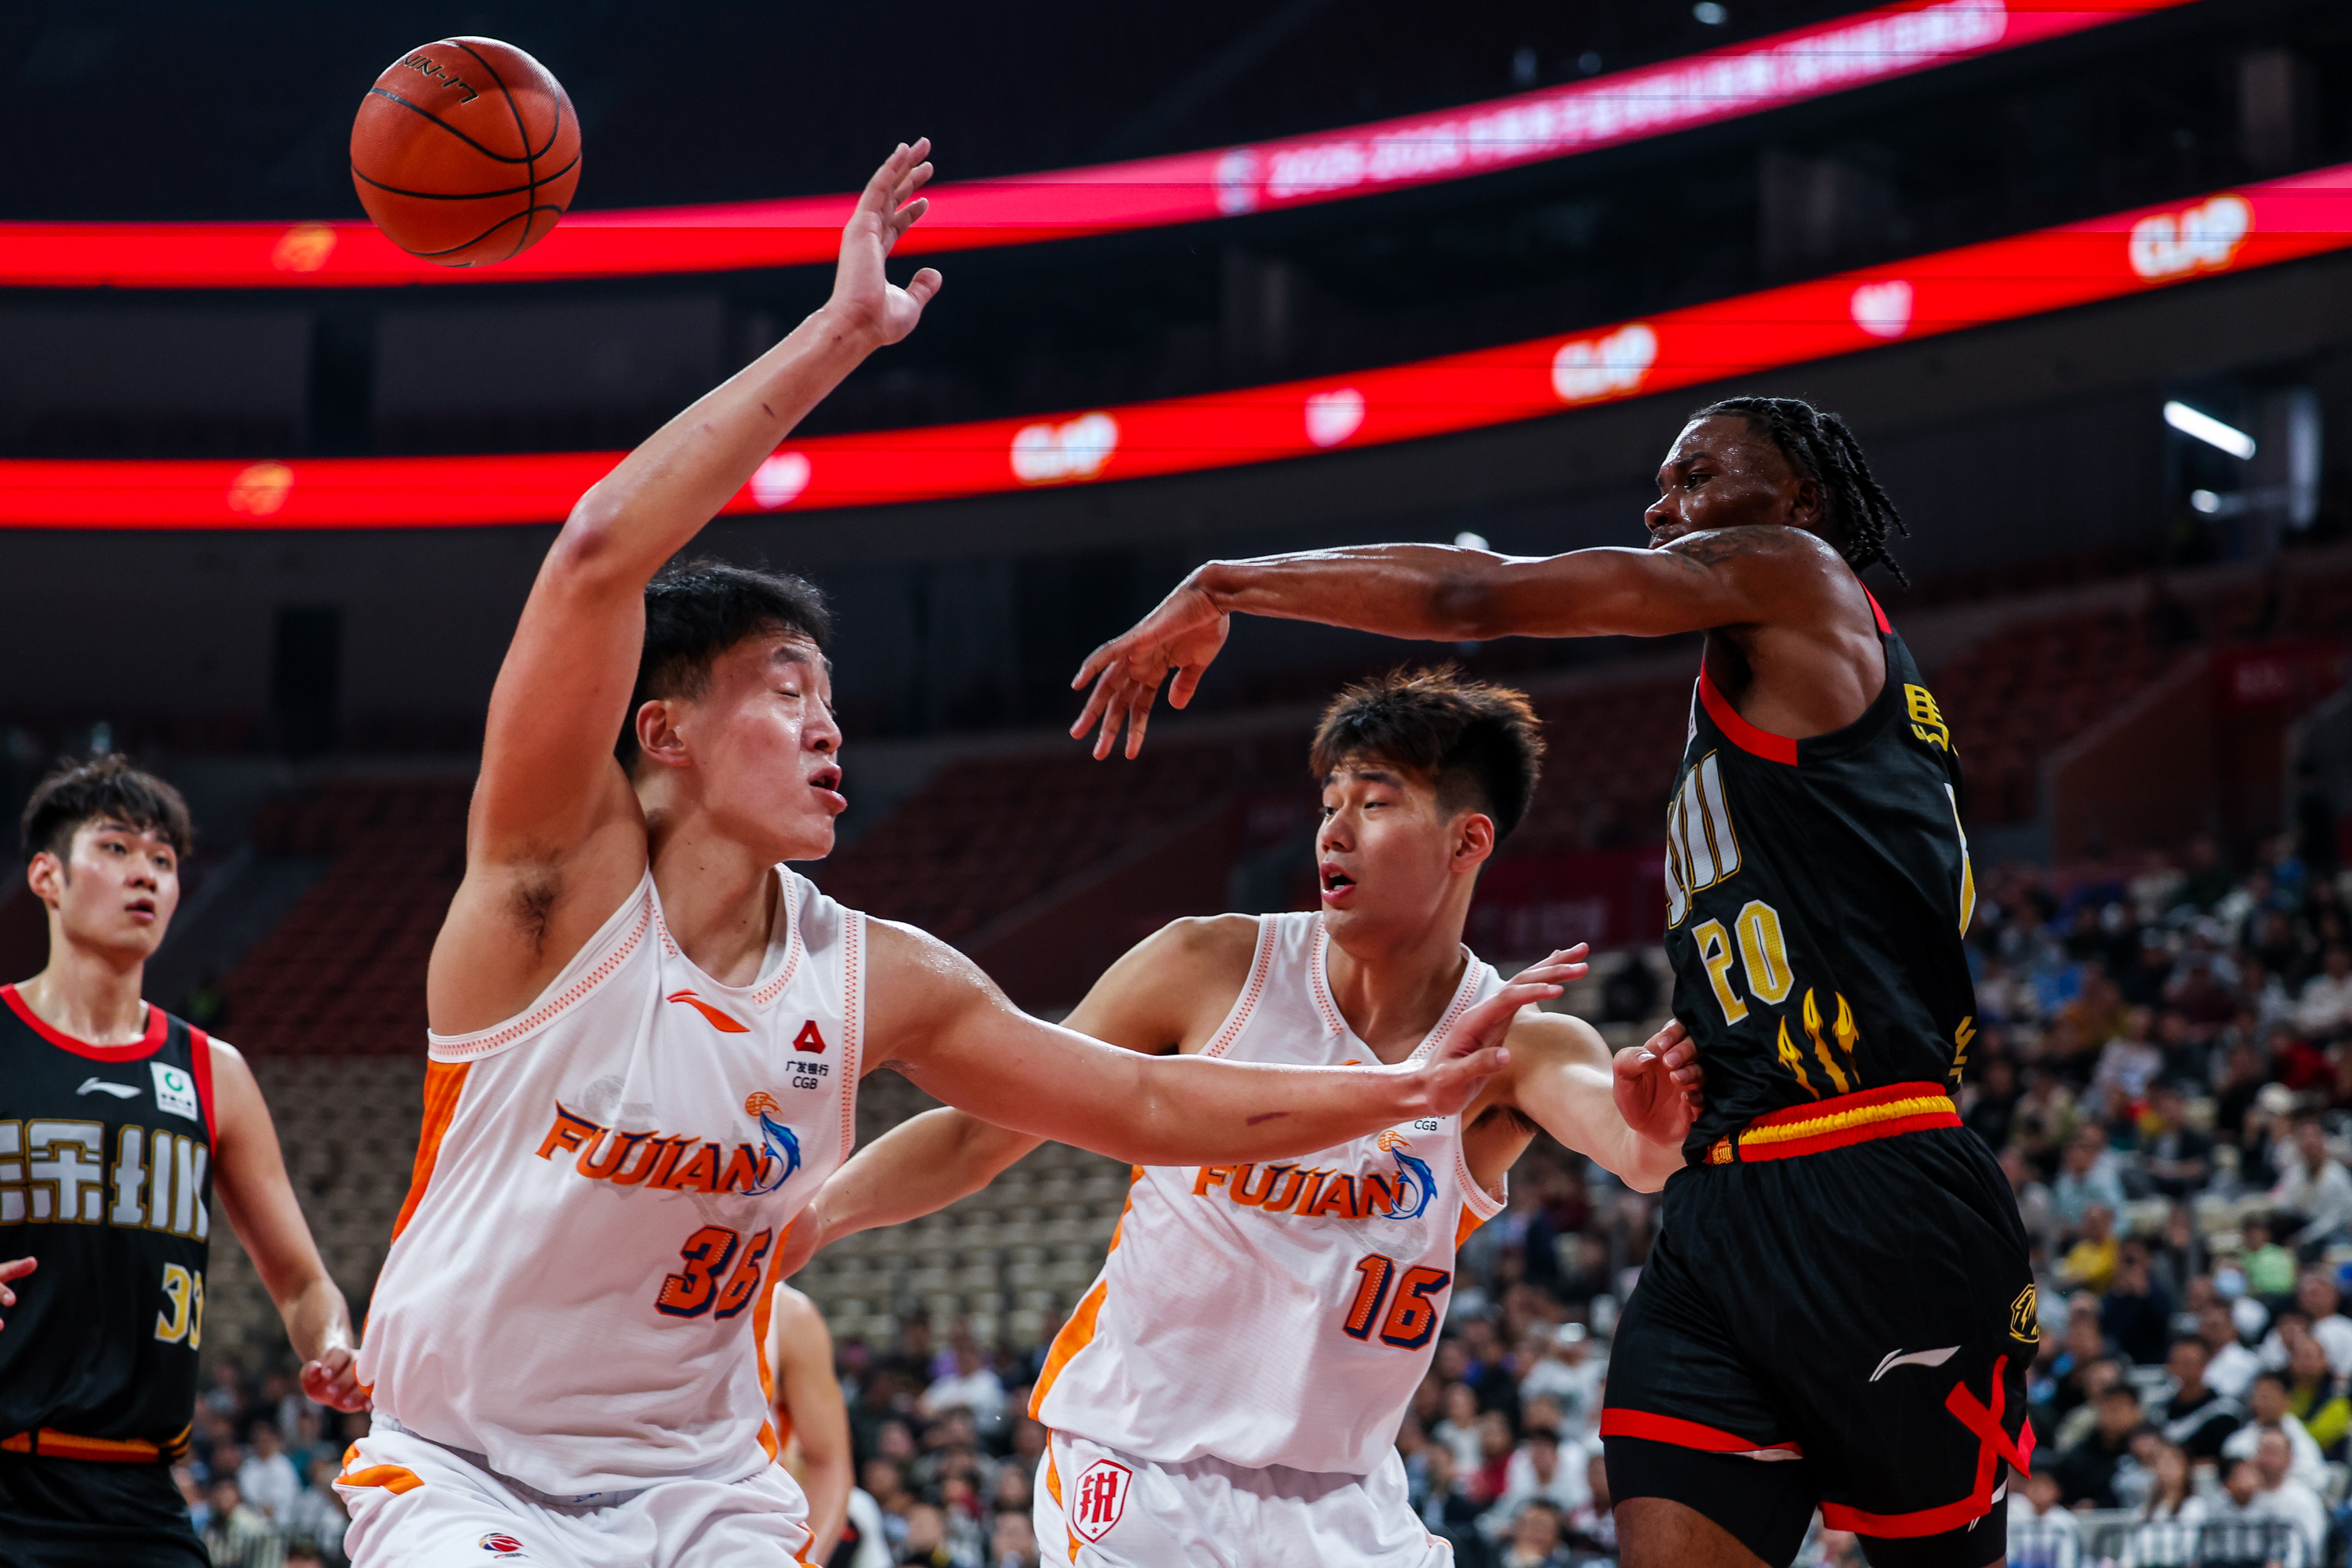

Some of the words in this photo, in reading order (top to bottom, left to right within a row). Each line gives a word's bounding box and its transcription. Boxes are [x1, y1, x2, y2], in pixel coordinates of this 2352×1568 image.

[786, 1060, 829, 1076] 广发银行
[793, 1076, 818, 1090] CGB
[535, 1099, 773, 1193] FUJIAN
[1414, 1120, 1438, 1131] CGB
[1191, 1163, 1407, 1220] FUJIAN
[654, 1225, 773, 1321] 36
[1342, 1253, 1451, 1351] 16
